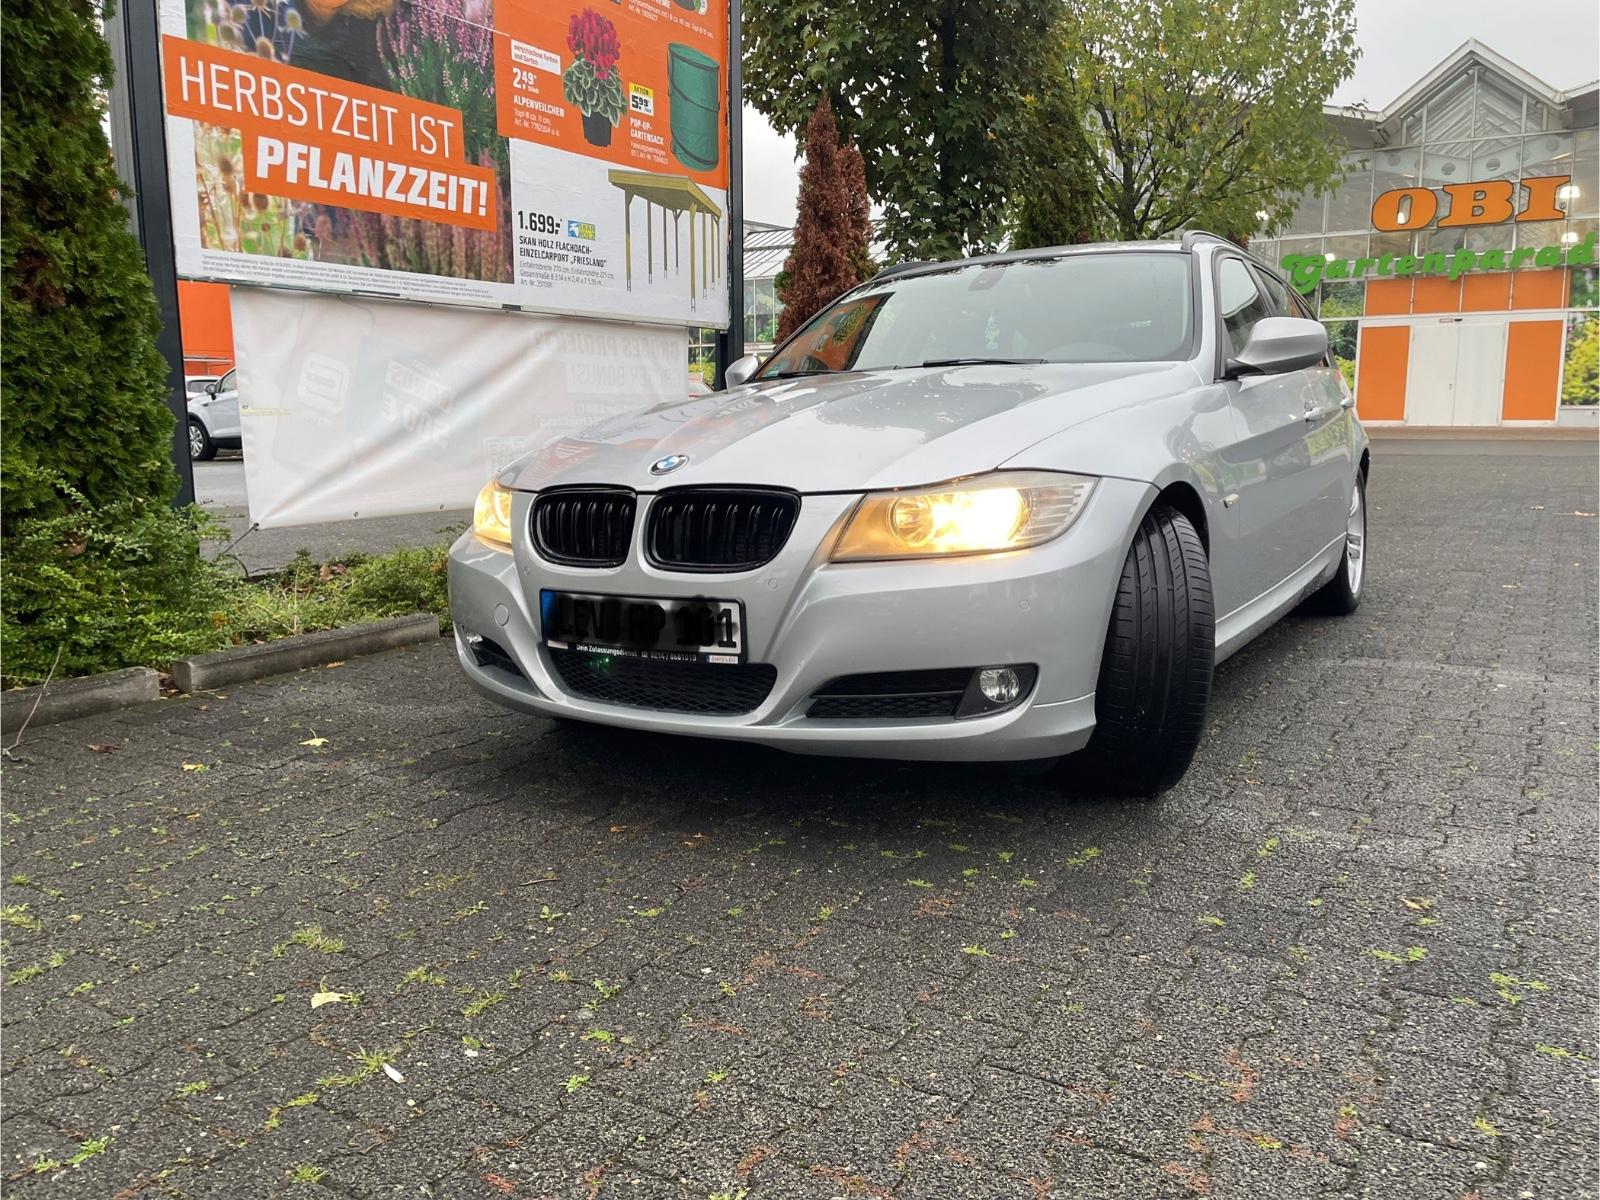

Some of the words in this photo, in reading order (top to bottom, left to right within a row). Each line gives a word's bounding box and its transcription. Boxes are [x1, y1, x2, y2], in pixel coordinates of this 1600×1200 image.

[633, 82, 649, 96] AKTION
[180, 56, 399, 146] HERBSTZEIT
[410, 112, 454, 159] IST
[514, 94, 565, 118] ALPENVEILCHEN
[630, 117, 652, 130] POP-UP-
[630, 129, 664, 146] GARTENSACK
[256, 136, 488, 217] PFLANZZEIT!
[1371, 175, 1571, 233] OBI
[520, 236, 536, 246] SKAN
[538, 238, 554, 250] HOLZ
[556, 242, 592, 255] FLACHDACH-
[520, 248, 568, 262] EINZELCARPORT
[576, 644, 588, 652] Dein
[588, 645, 638, 658] Zulassungsdienst
